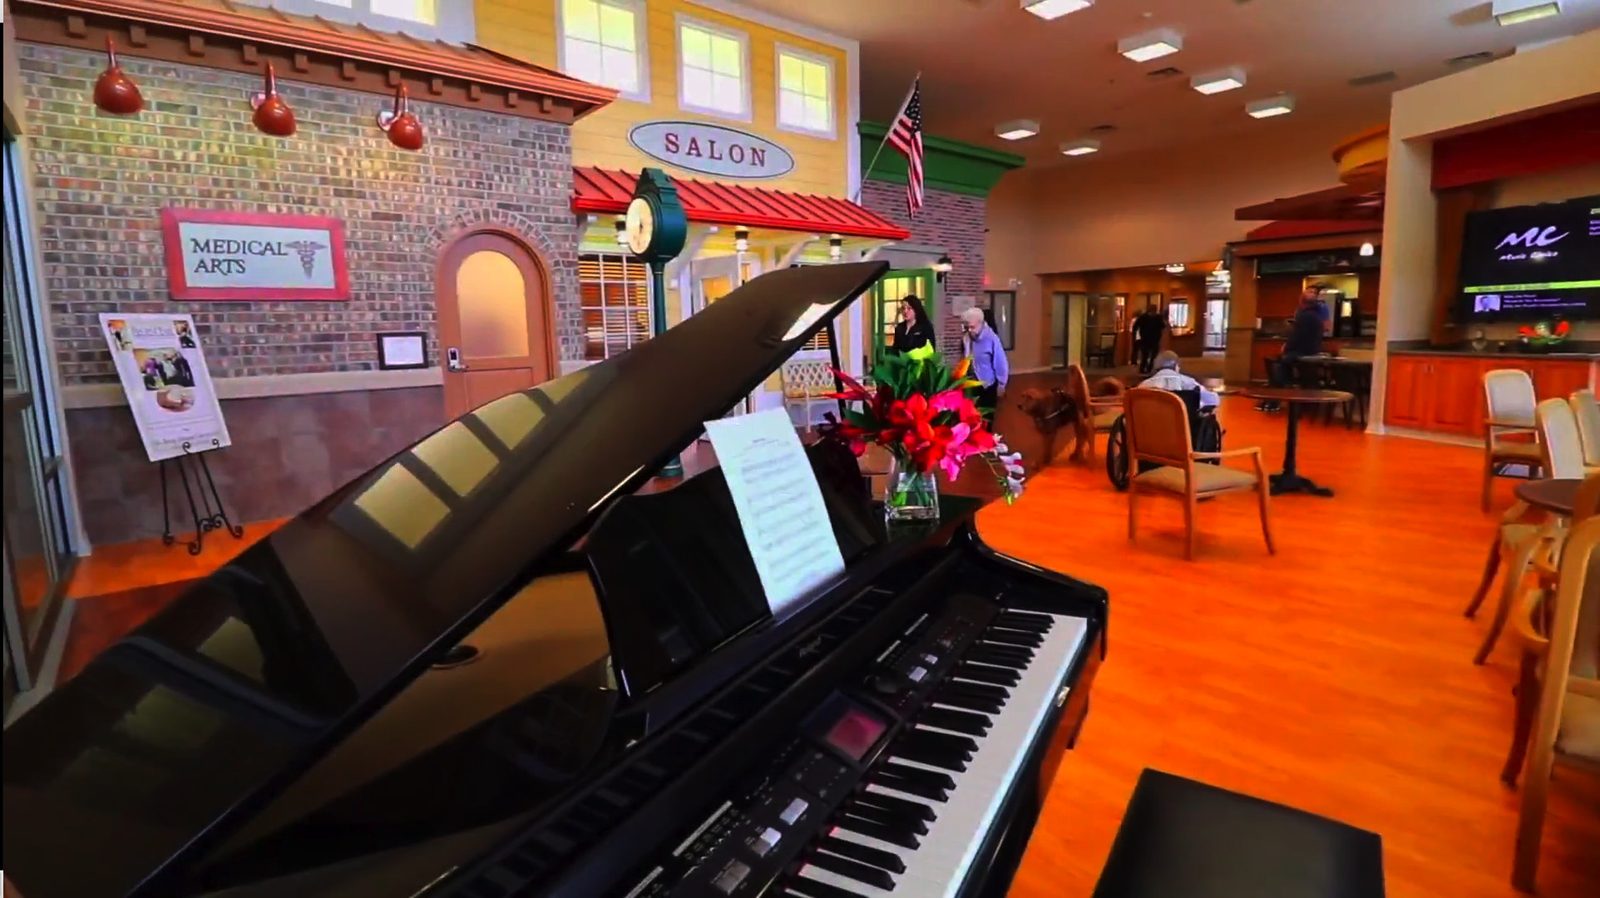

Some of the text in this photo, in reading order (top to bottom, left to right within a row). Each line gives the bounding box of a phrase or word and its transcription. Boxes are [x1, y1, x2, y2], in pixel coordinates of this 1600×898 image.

[664, 132, 767, 168] SALON
[190, 238, 288, 256] MEDICAL
[1494, 225, 1570, 250] MC
[194, 258, 246, 276] ARTS
